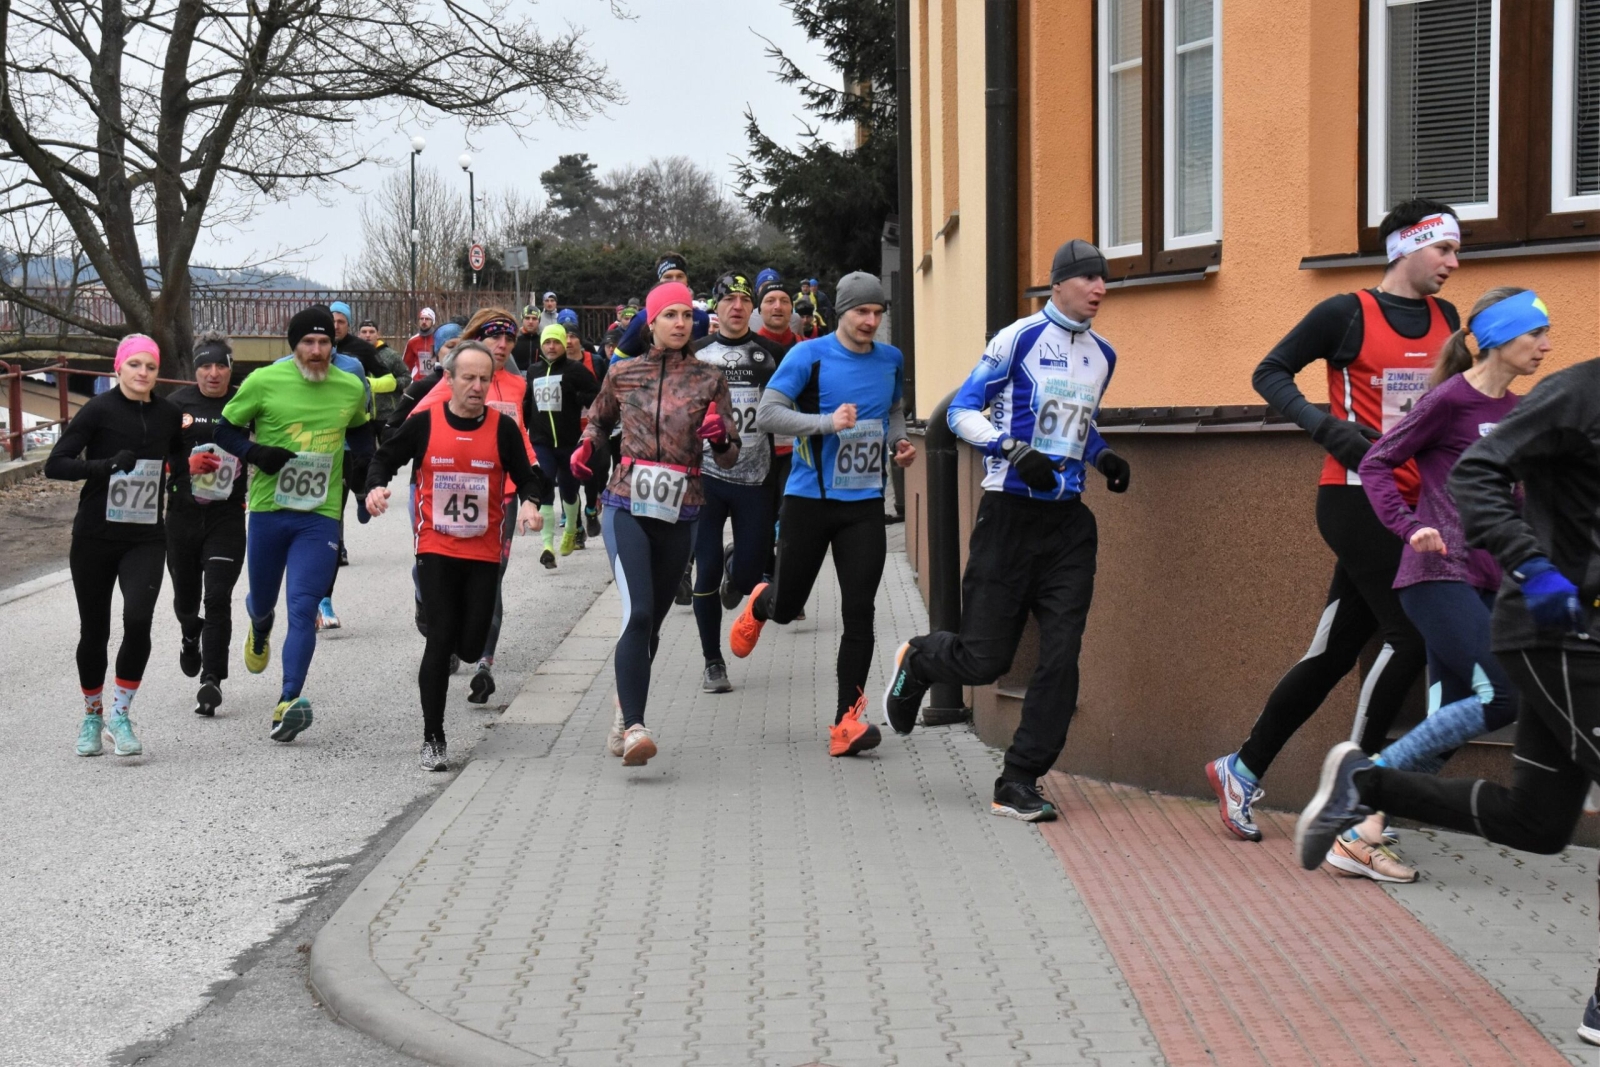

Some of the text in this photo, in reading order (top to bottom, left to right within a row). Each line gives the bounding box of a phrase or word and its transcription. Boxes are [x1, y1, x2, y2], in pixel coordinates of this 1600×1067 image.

[1400, 220, 1444, 241] MARATON
[1387, 382, 1425, 391] BĚŽECKÁ
[1388, 372, 1414, 381] ZIMNÍ
[534, 386, 561, 403] 664
[1044, 385, 1076, 398] BĚŽECKÁ
[1080, 392, 1095, 402] LIGA
[1039, 400, 1092, 442] 675
[838, 442, 880, 474] 652
[111, 479, 158, 509] 672
[280, 467, 327, 499] 663
[435, 482, 466, 490] BĚŽECKÁ
[636, 468, 685, 507] 661
[444, 494, 479, 522] 45
